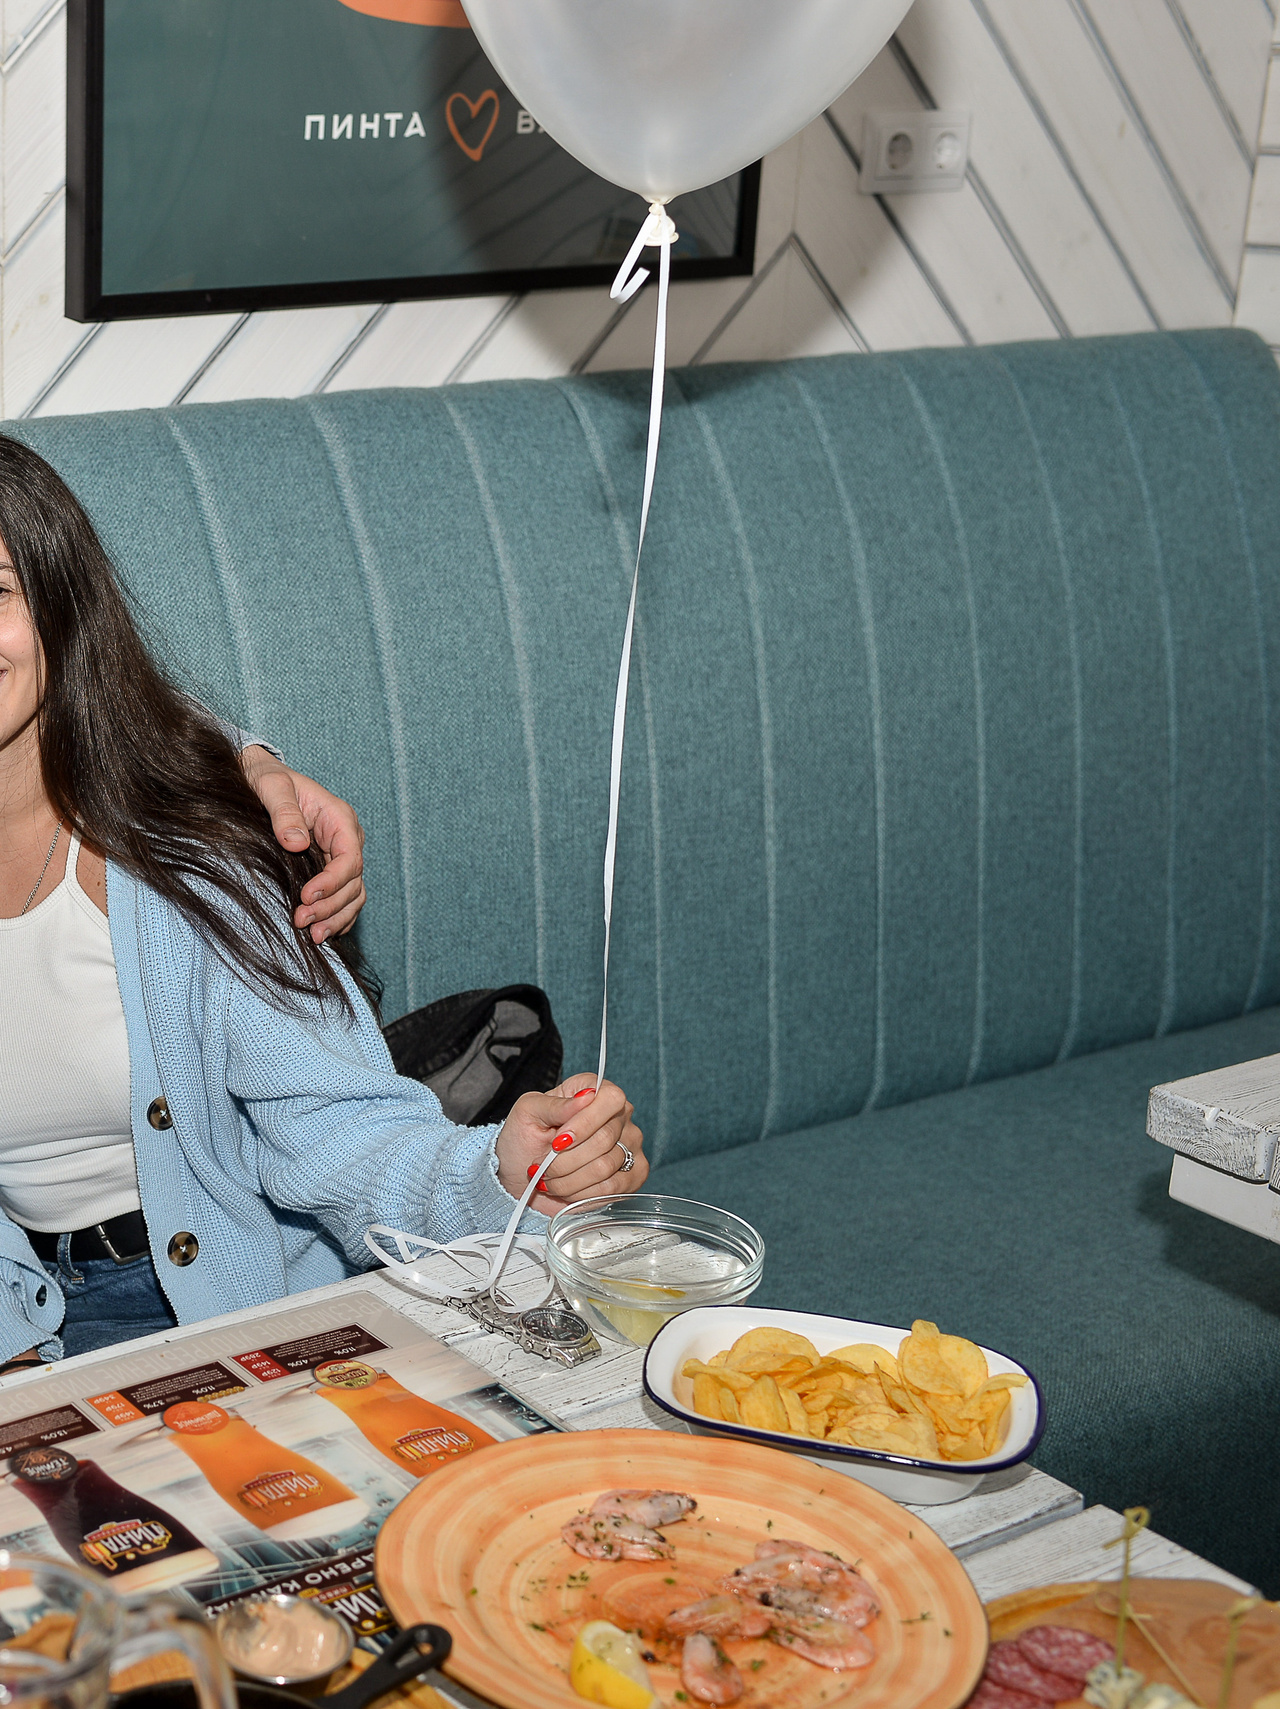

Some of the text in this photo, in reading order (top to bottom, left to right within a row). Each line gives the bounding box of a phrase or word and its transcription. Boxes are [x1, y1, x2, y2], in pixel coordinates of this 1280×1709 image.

[303, 111, 427, 141] ПИНТА
[96, 1329, 255, 1384] УПОТРЕБЛЕНИЕ
[34, 1374, 101, 1403] ПИВА
[409, 1431, 470, 1455] ПИНТА
[257, 1474, 319, 1500] ПИНТА
[99, 1523, 166, 1553] ПИНТА
[304, 1553, 375, 1585] АРЕНО
[325, 1588, 381, 1622] ПИН
